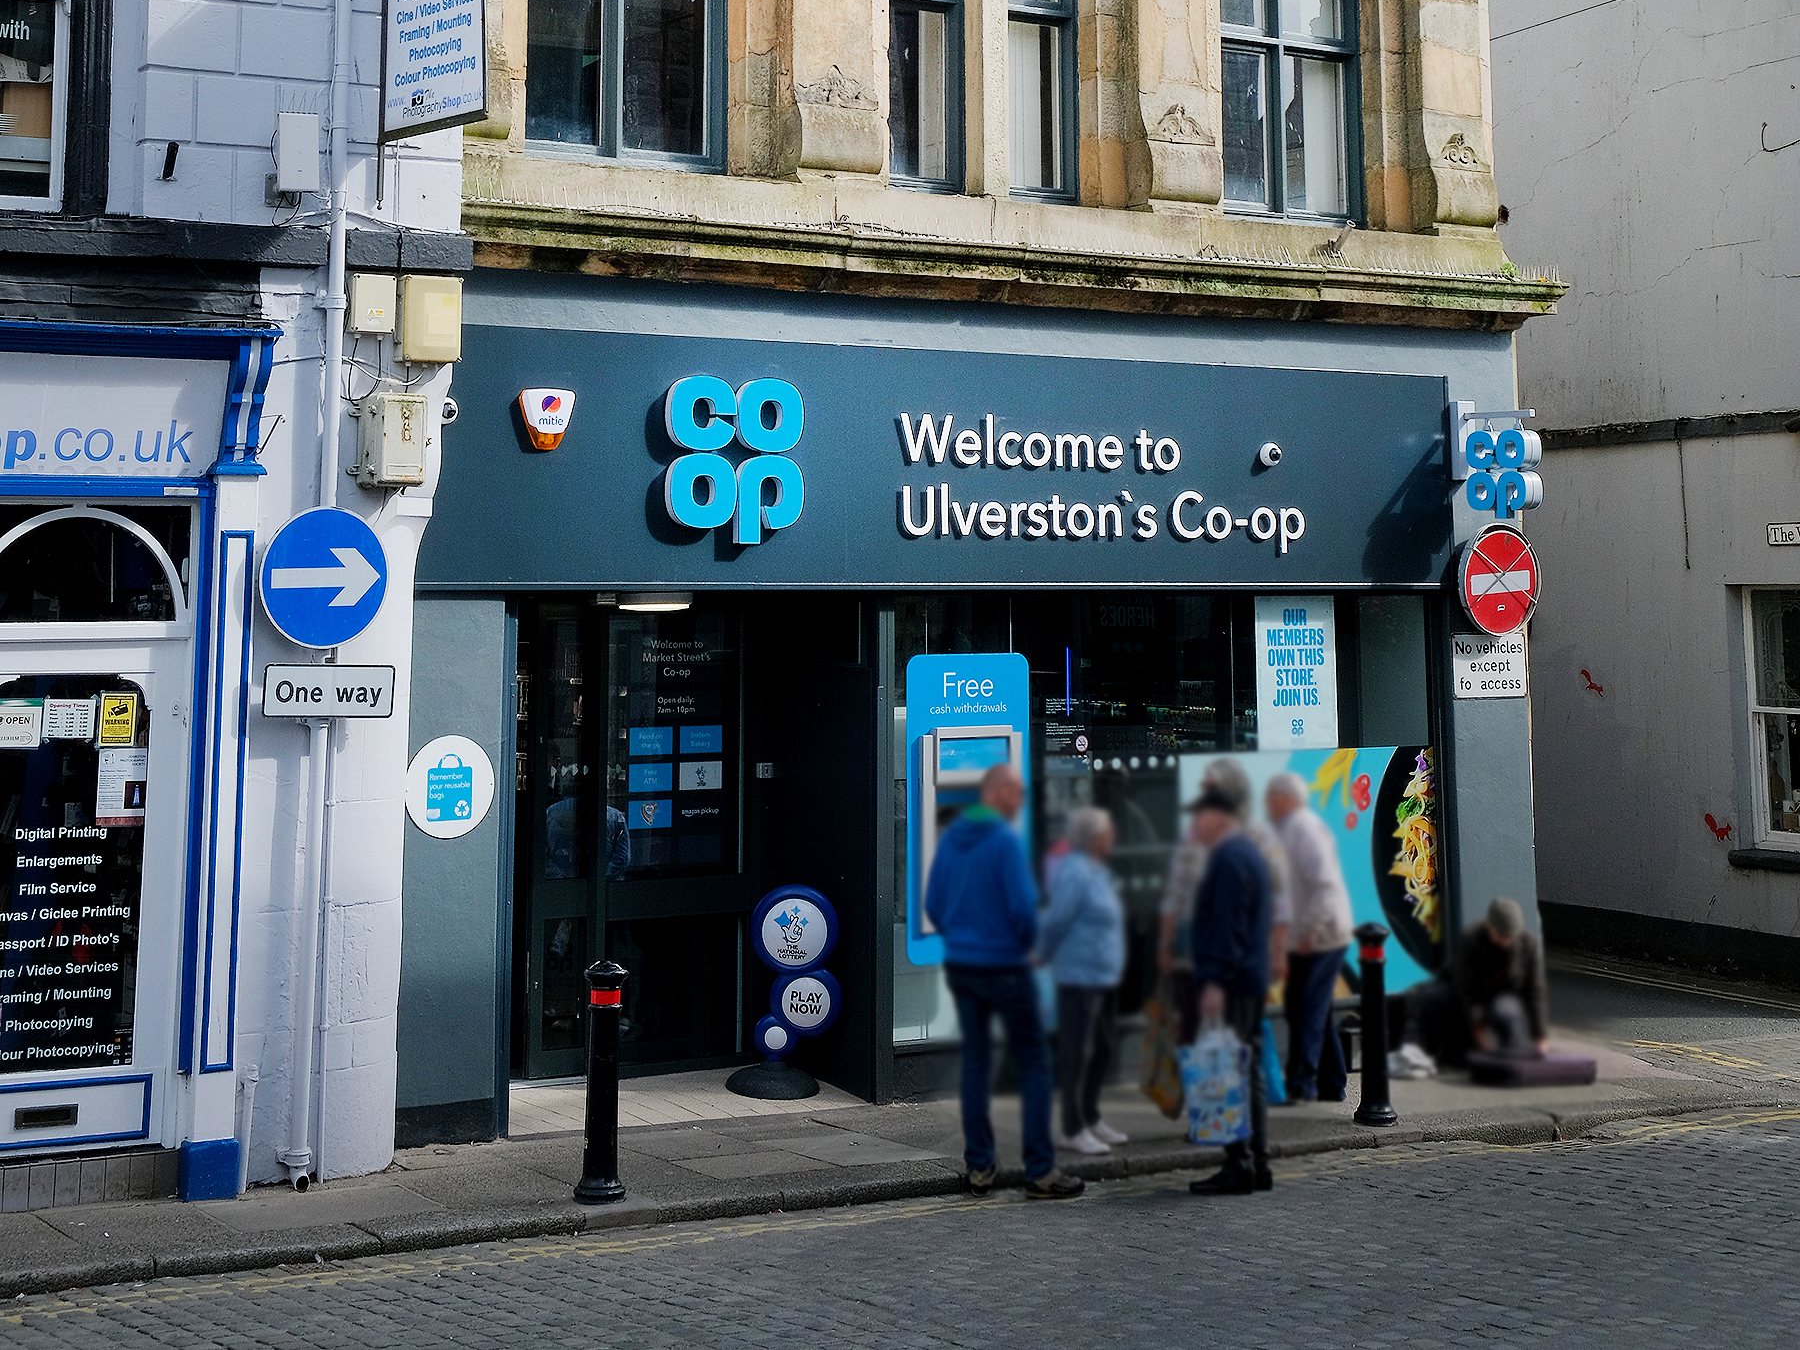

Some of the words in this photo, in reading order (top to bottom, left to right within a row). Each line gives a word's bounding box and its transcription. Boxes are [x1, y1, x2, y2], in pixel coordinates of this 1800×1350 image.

[396, 11, 413, 25] Cine
[419, 2, 440, 18] Video
[0, 19, 30, 40] with
[399, 25, 430, 44] Framing
[436, 12, 472, 33] Mounting
[409, 37, 462, 62] Photocopying
[394, 71, 421, 87] Colour
[422, 56, 476, 80] Photocopying
[539, 415, 564, 425] mitie
[0, 419, 194, 470] p.co.uk
[900, 412, 1124, 470] Welcome
[1136, 428, 1182, 472] to
[1171, 490, 1307, 554] Co-op
[1770, 527, 1795, 543] The
[1283, 608, 1307, 626] OUR
[650, 639, 692, 649] Welcome
[694, 640, 704, 648] to
[1267, 628, 1325, 646] MEMBERS
[1455, 641, 1472, 654] No
[1476, 640, 1523, 654] vehicles
[642, 652, 675, 662] Market
[677, 652, 711, 661] Street's
[1268, 648, 1296, 667] OWN
[1297, 648, 1325, 666] THIS
[663, 667, 691, 678] Co-op
[1470, 659, 1511, 674] except
[1276, 668, 1317, 686] STORE.
[1480, 679, 1521, 690] access
[943, 672, 994, 698] Free
[276, 680, 323, 703] One
[336, 687, 383, 708] way
[657, 696, 676, 705] Open
[1273, 689, 1301, 707] JOIN
[1303, 688, 1321, 706] US.
[657, 706, 671, 714] 7am
[676, 706, 696, 714] 10pm
[930, 703, 951, 714] cash
[953, 701, 1008, 714] withdrawals
[6, 716, 30, 725] OPEN
[429, 773, 463, 781] Remember
[429, 783, 443, 791] your
[444, 781, 471, 789] reusable
[429, 790, 445, 800] bags
[701, 807, 719, 815] pickup
[15, 827, 55, 842] Digital
[58, 826, 108, 839] Printing
[16, 853, 103, 869] Enlargements
[19, 883, 46, 895] Film
[49, 881, 97, 894] Service
[39, 907, 79, 920] Giclee
[82, 905, 131, 918] Printing
[56, 935, 69, 947] ID
[73, 932, 120, 946] Photo's
[26, 964, 62, 976] Video
[65, 961, 119, 974] Services
[53, 986, 112, 1000] Mounting
[790, 990, 823, 1003] PLAY
[789, 1002, 822, 1015] NOW
[5, 1015, 94, 1032] Photocopying
[27, 1042, 115, 1058] Photocopying
